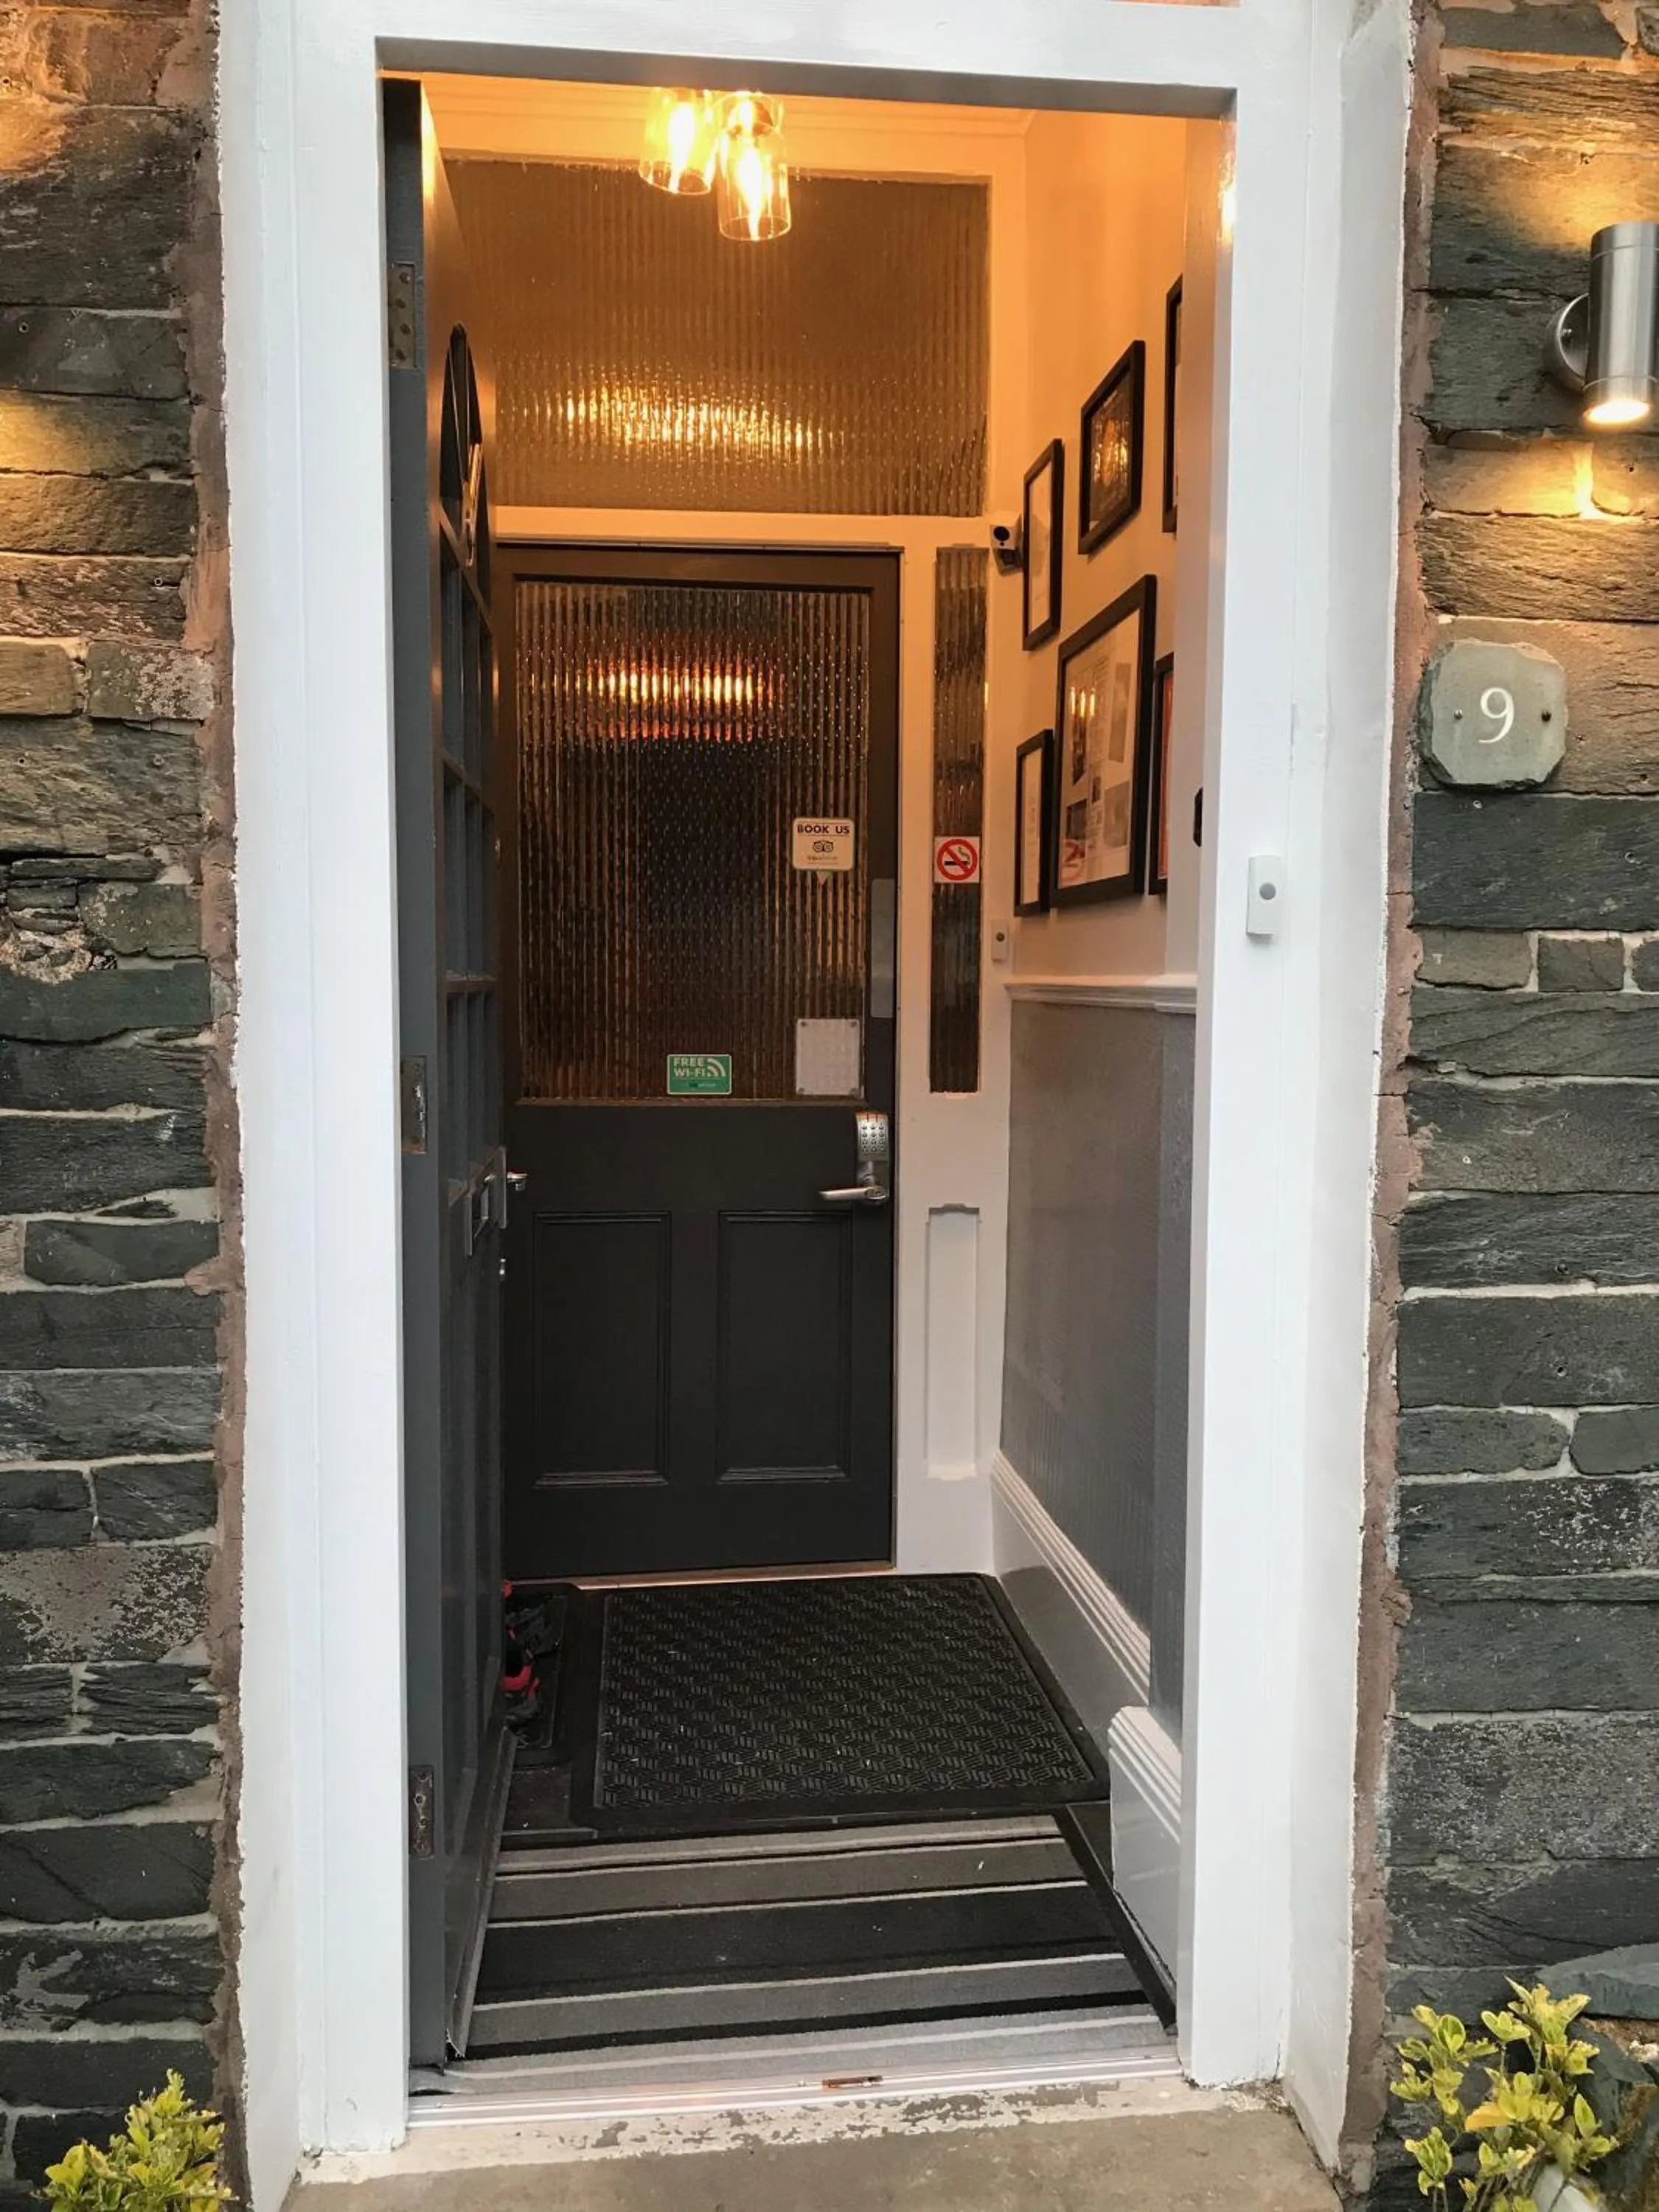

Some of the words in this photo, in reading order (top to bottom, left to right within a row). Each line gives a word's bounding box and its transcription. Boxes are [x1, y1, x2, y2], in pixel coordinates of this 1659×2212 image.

[1478, 686, 1514, 743] 9
[797, 824, 830, 833] BOOK
[835, 825, 850, 834] US
[673, 1057, 705, 1067] FREE
[673, 1067, 706, 1077] WI-FI
